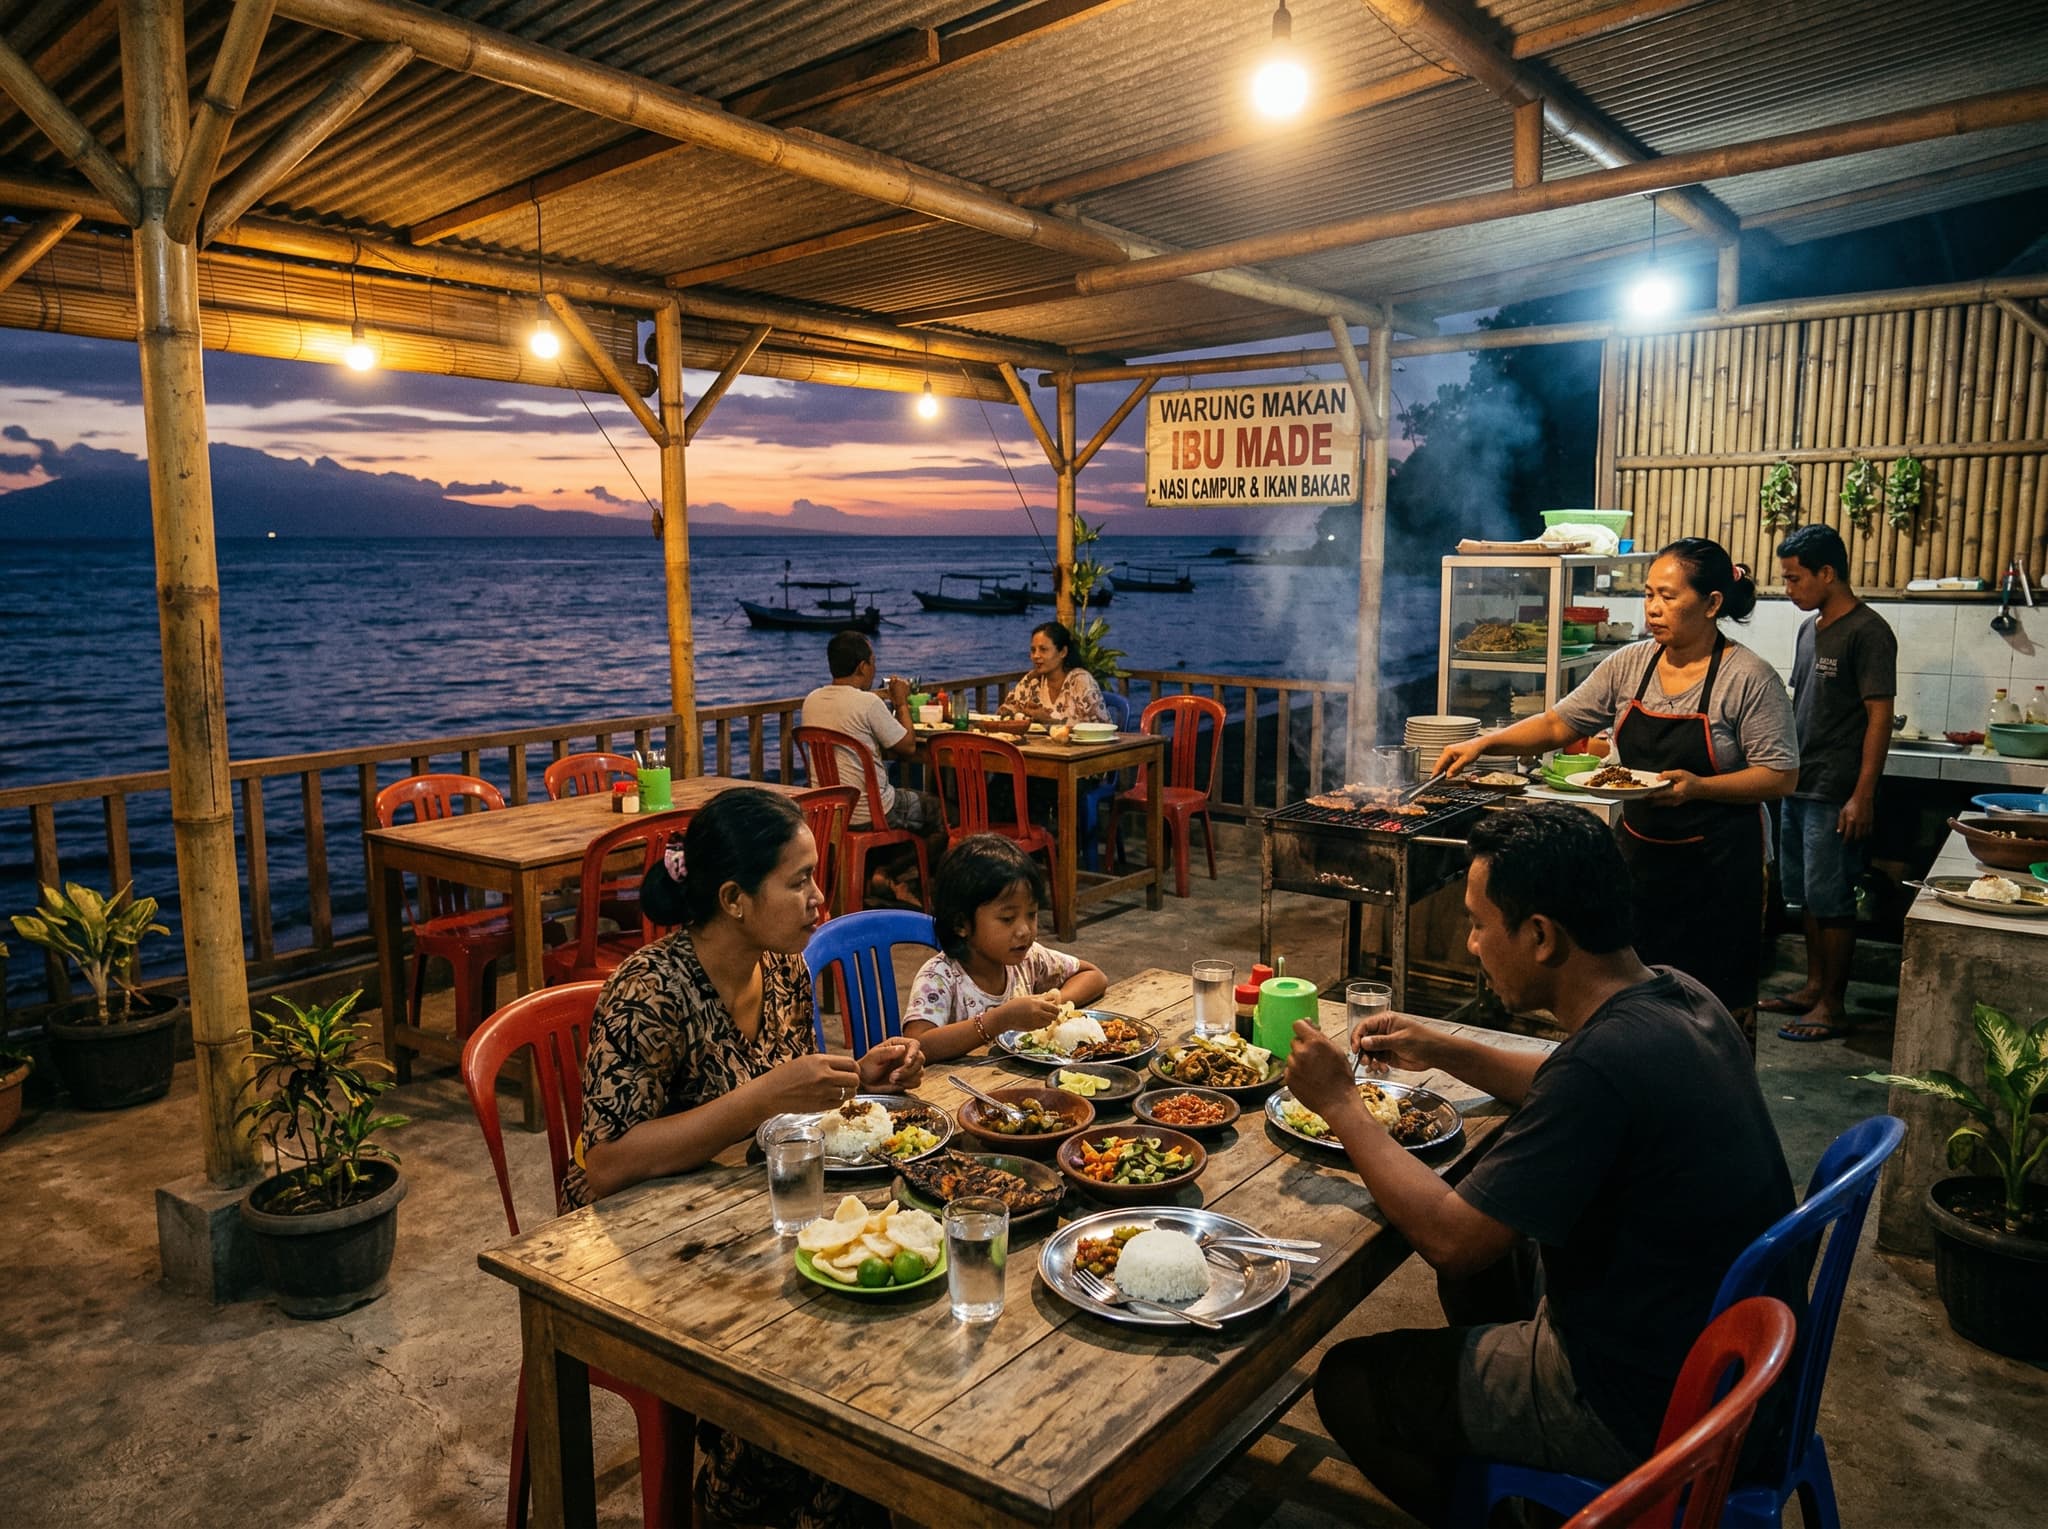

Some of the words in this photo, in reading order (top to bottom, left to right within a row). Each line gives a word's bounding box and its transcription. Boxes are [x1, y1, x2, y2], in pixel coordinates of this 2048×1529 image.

[1160, 394, 1255, 423] WARUNG
[1262, 388, 1346, 418] MAKAN
[1172, 428, 1225, 470] IBU
[1236, 423, 1332, 468] MADE
[1159, 478, 1188, 500] NASI
[1192, 476, 1245, 499] CAMPUR
[1250, 476, 1259, 498] &
[1264, 475, 1297, 498] IKAN
[1301, 473, 1351, 497] BAKAR
